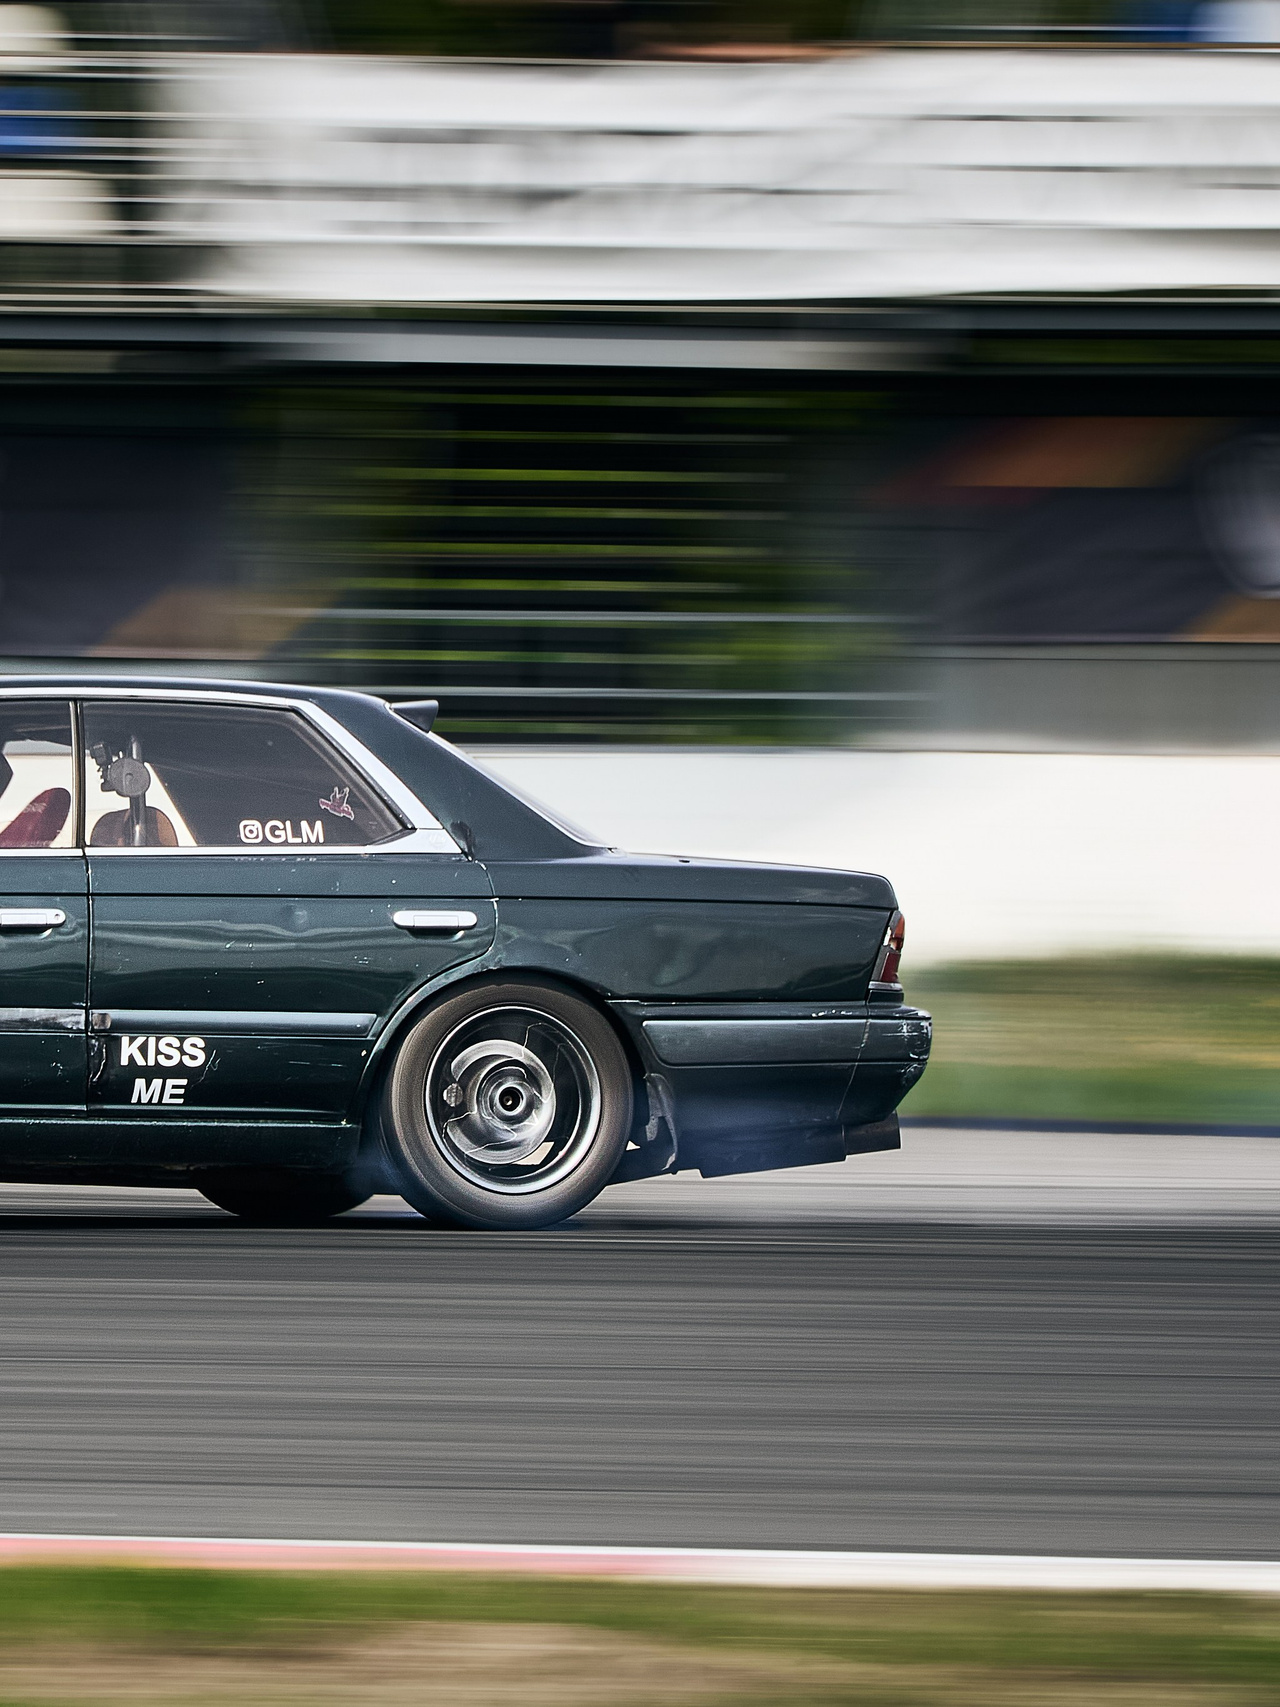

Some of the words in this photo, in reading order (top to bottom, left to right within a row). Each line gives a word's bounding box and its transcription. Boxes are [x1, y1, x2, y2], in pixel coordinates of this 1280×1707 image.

[264, 820, 324, 843] GLM
[120, 1036, 206, 1067] KISS
[130, 1078, 188, 1104] ME
